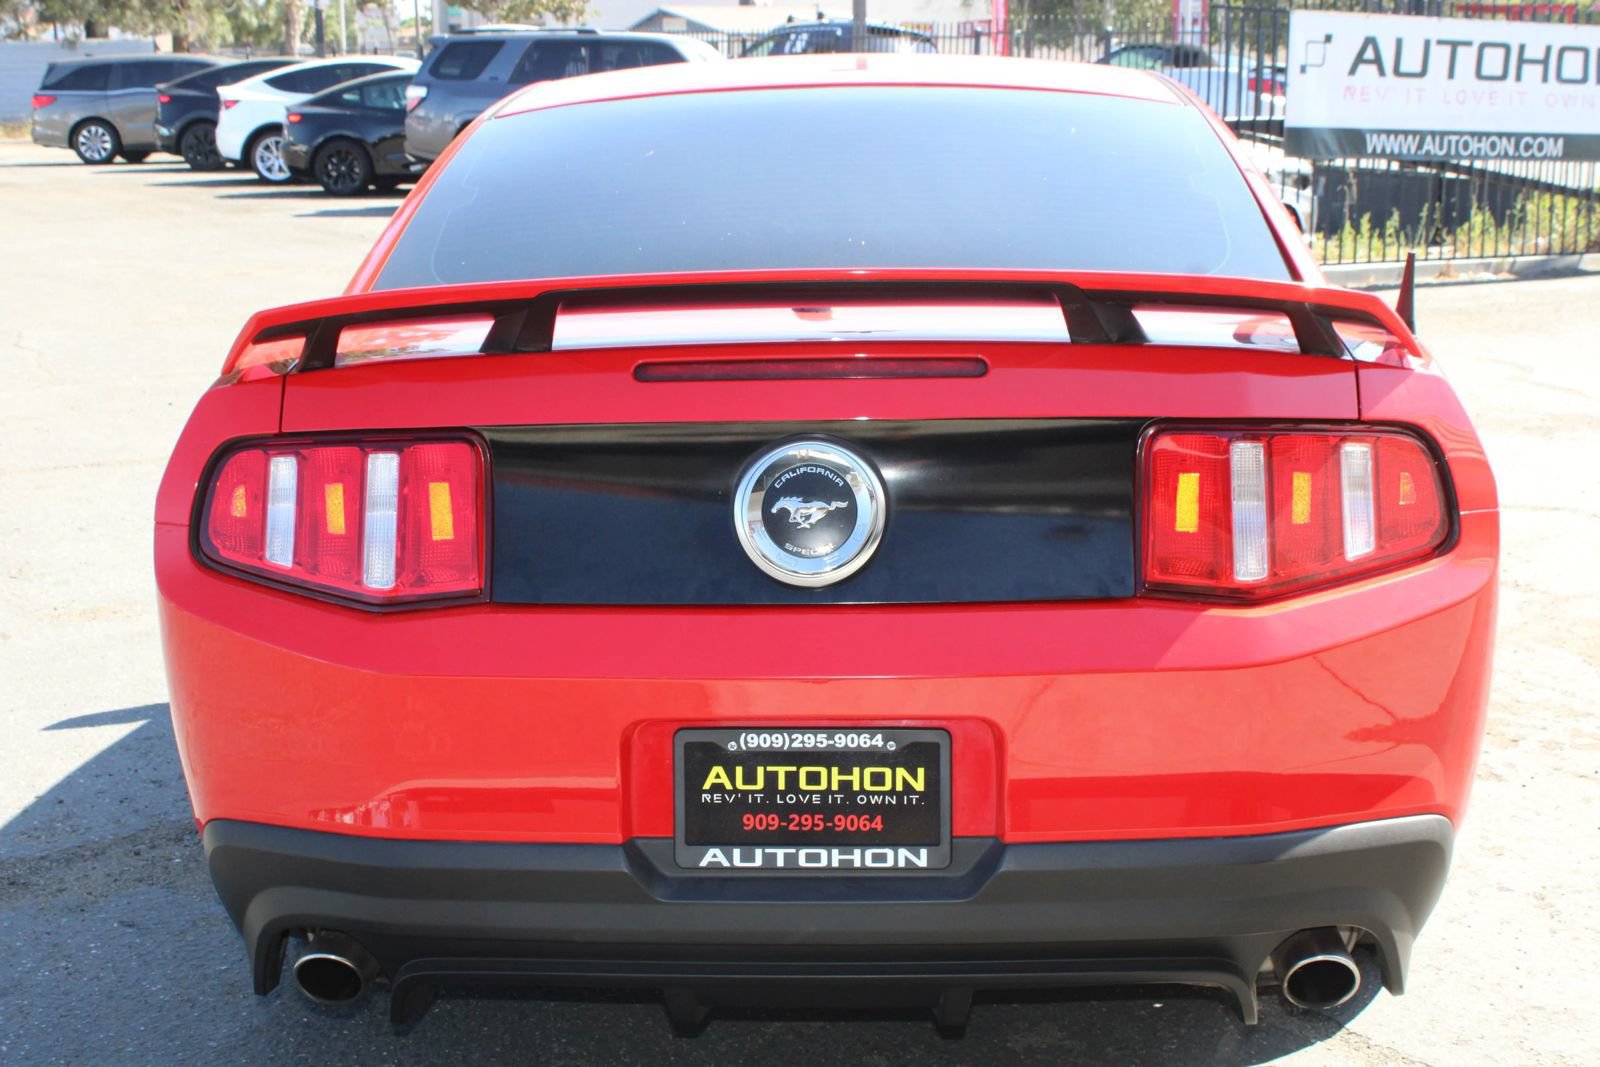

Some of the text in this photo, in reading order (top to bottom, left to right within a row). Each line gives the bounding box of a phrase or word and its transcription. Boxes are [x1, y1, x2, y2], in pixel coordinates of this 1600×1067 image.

[1348, 36, 1600, 85] AUTOHO
[1366, 133, 1564, 158] WWW.AUTOHON.COM
[774, 466, 844, 488] CALIFORNIA
[784, 542, 837, 556] SPECL
[740, 732, 884, 751] (909)295-9064
[702, 766, 925, 791] AUTOHON
[701, 793, 925, 805] REV' IT. LOVE IT. OWN IT.
[742, 813, 883, 832] 909-295-9064
[698, 847, 928, 868] AUTOHON
